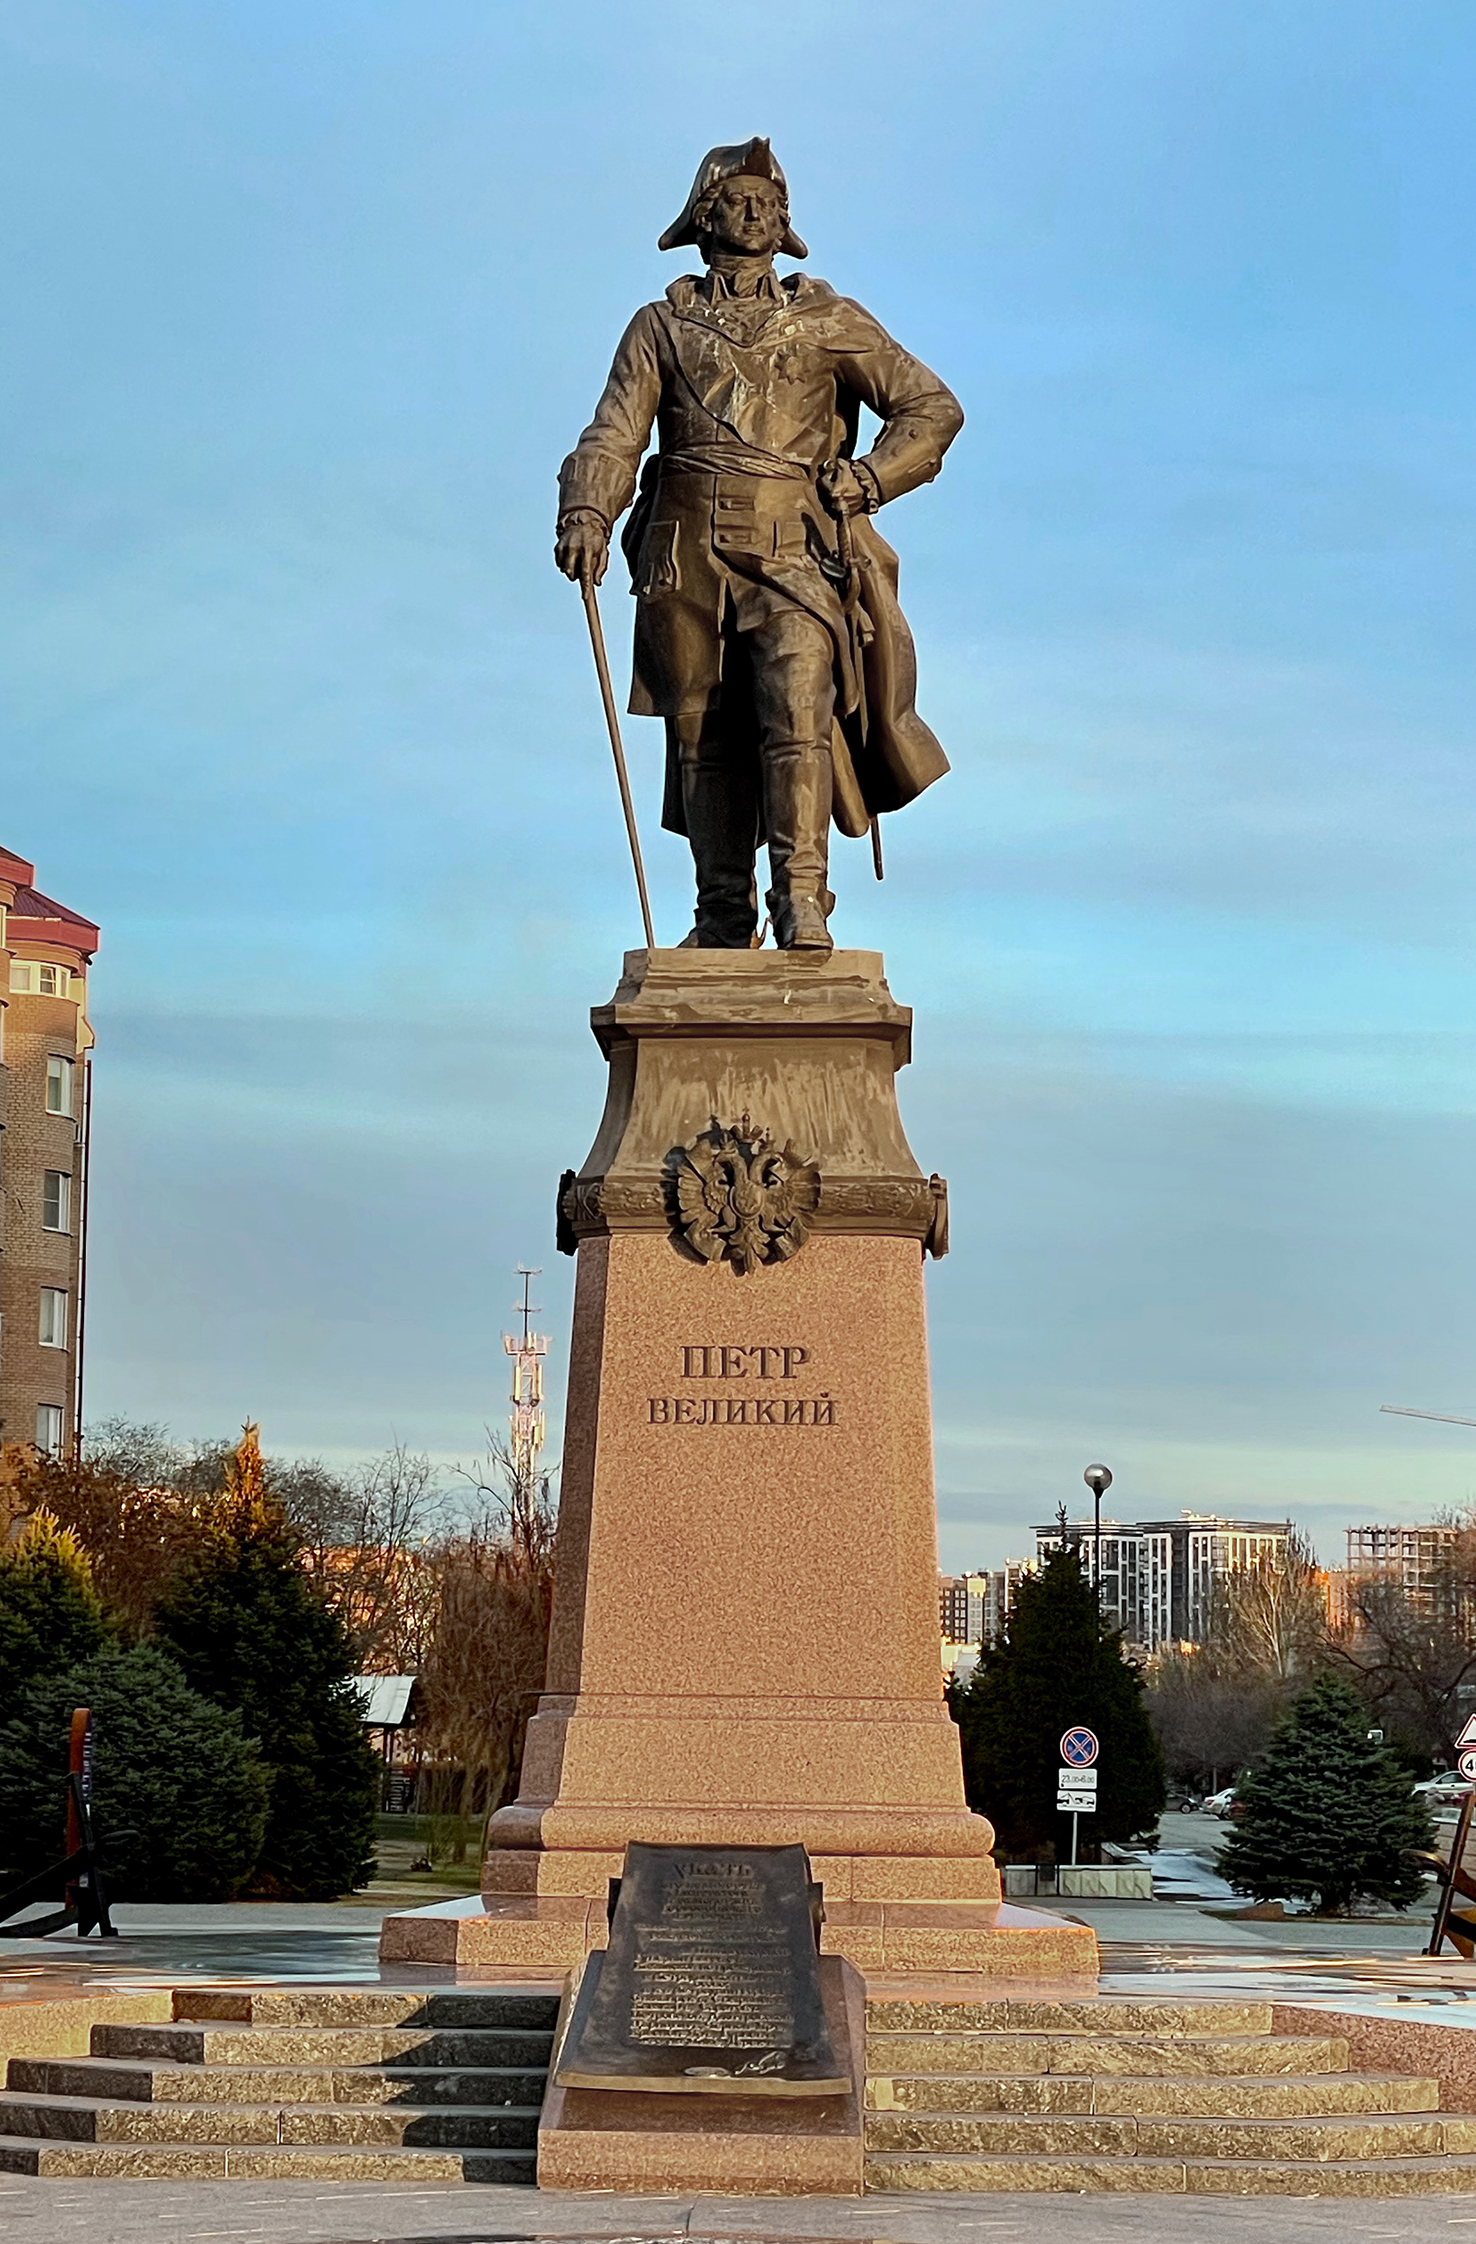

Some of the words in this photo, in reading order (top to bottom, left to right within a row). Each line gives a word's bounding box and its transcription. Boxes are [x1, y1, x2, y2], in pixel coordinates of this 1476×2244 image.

[680, 1345, 810, 1379] ПЕТР
[647, 1392, 839, 1426] ВЕЛИКИЙ
[1465, 1760, 1476, 1771] 4
